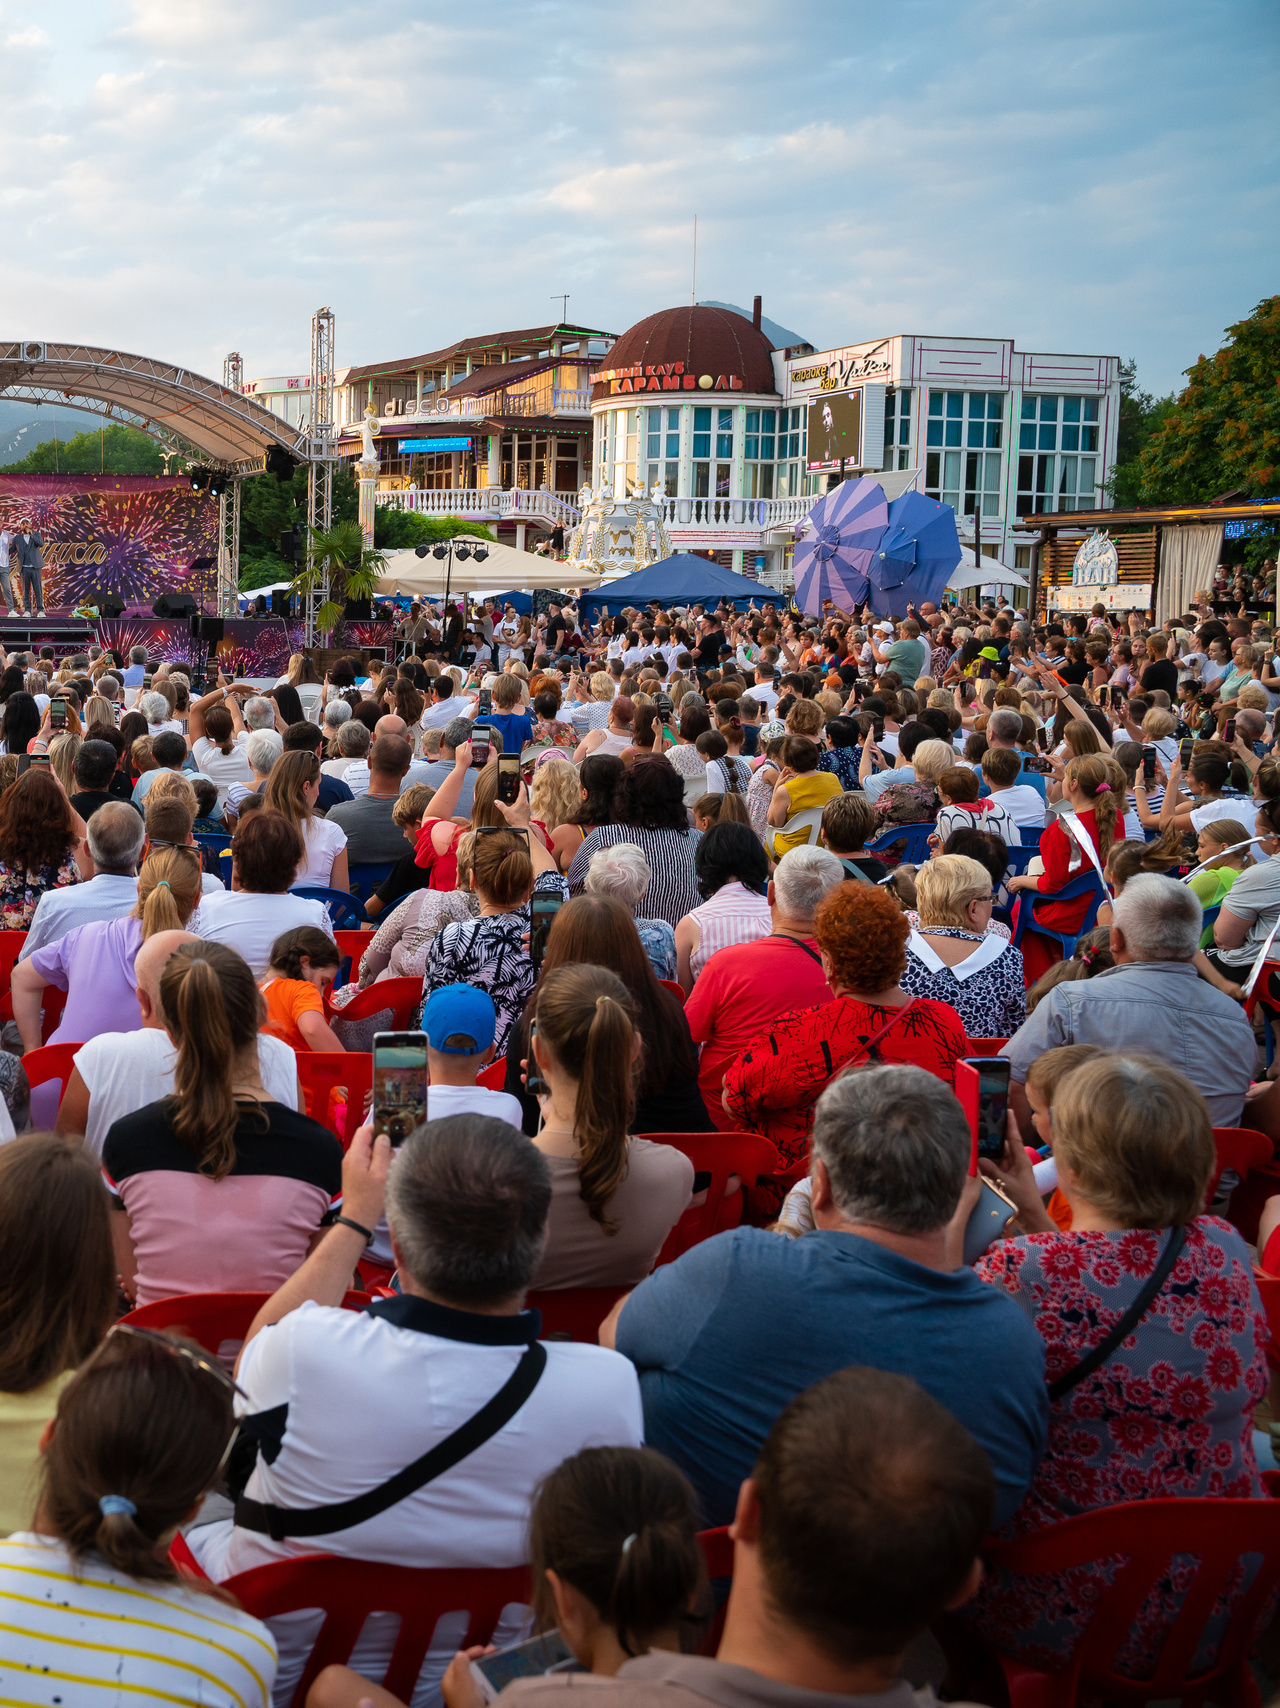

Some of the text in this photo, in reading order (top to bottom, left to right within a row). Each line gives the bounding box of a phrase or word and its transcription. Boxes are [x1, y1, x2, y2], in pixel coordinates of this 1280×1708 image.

[645, 361, 685, 376] КЛУБ
[791, 365, 828, 382] караоке
[610, 374, 743, 394] КАРАМБОЛЬ
[819, 377, 836, 389] бар
